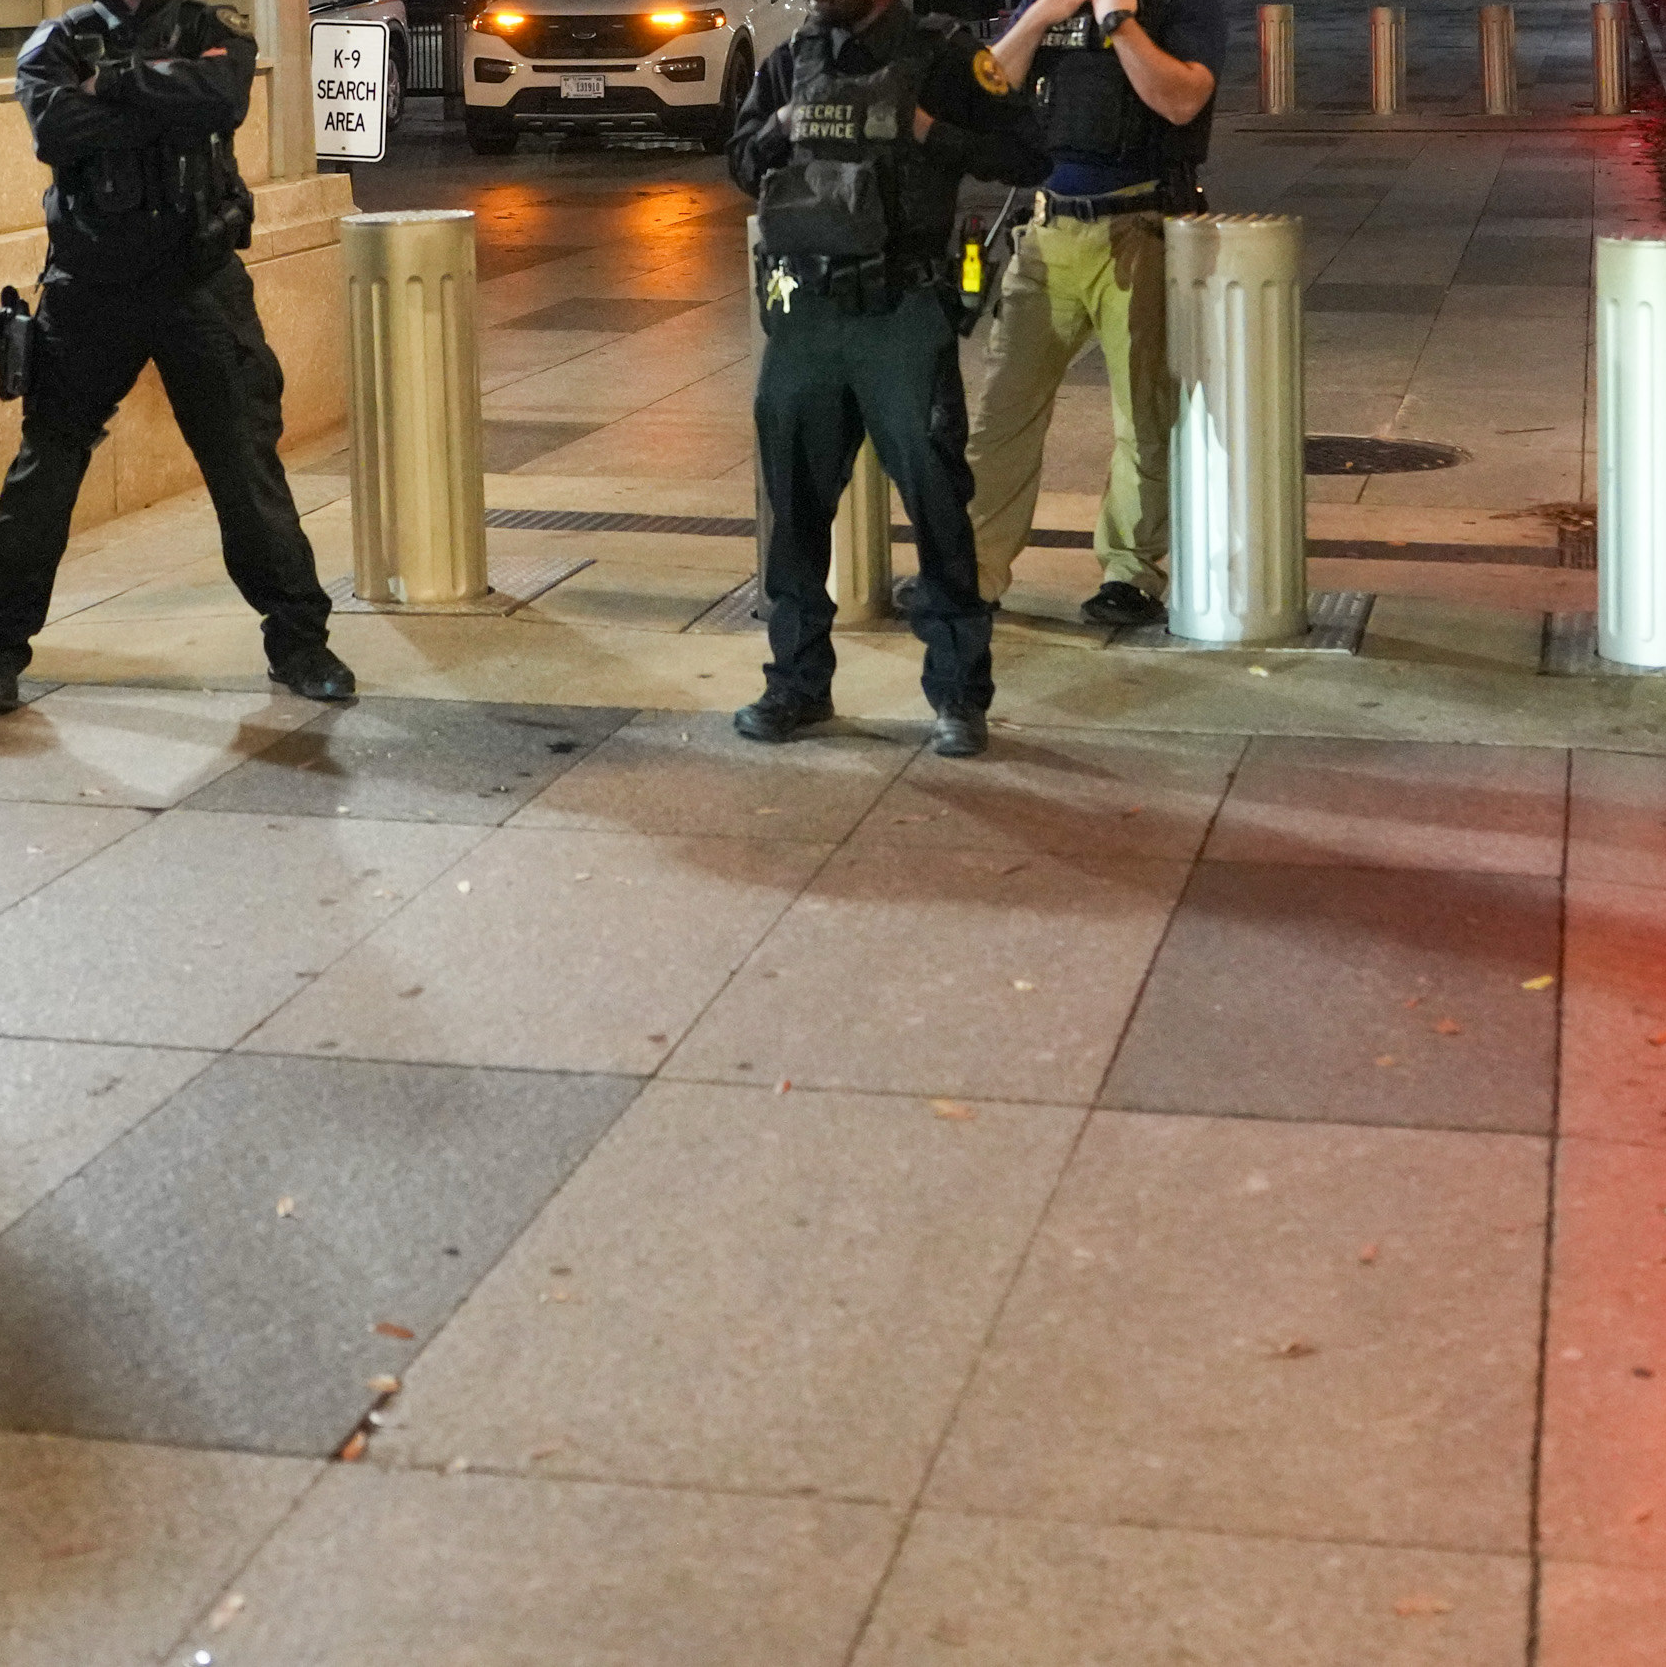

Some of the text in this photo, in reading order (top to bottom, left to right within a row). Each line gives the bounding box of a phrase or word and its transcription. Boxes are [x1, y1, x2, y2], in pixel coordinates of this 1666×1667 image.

[334, 49, 361, 69] K-9
[317, 79, 376, 101] SEARCH
[324, 112, 365, 132] AREA
